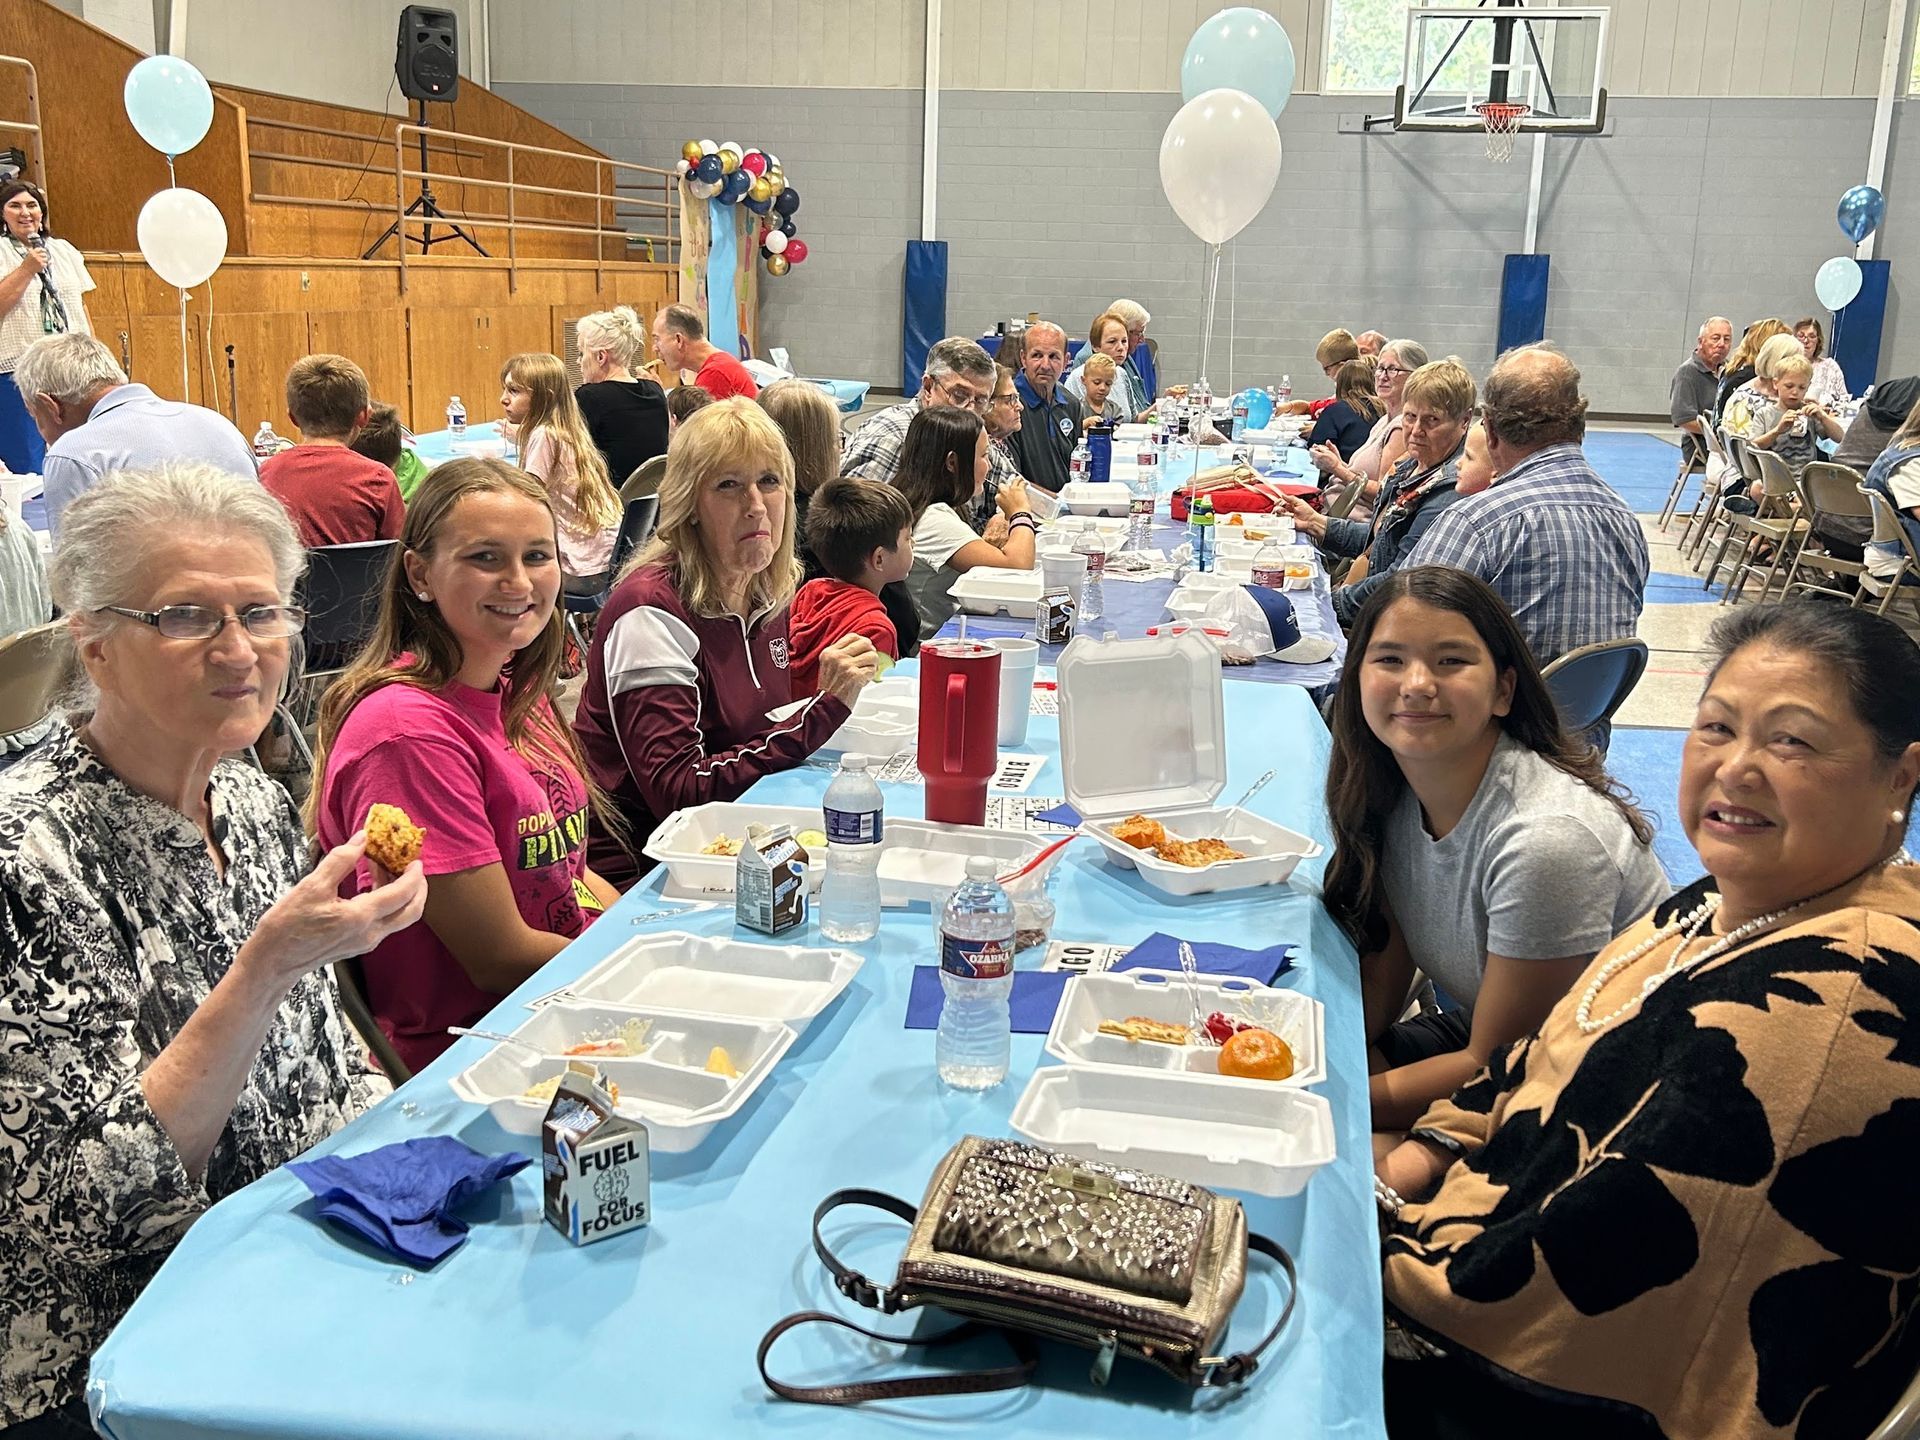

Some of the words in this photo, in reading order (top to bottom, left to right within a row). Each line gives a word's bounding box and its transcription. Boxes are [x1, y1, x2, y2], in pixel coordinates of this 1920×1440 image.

[996, 761, 1031, 788] BINGO
[969, 951, 1009, 964] OZARKA
[1058, 947, 1095, 975] NGO
[579, 1140, 640, 1177] FUEL
[582, 1202, 645, 1237] FOCUS
[599, 1196, 629, 1216] FOR
